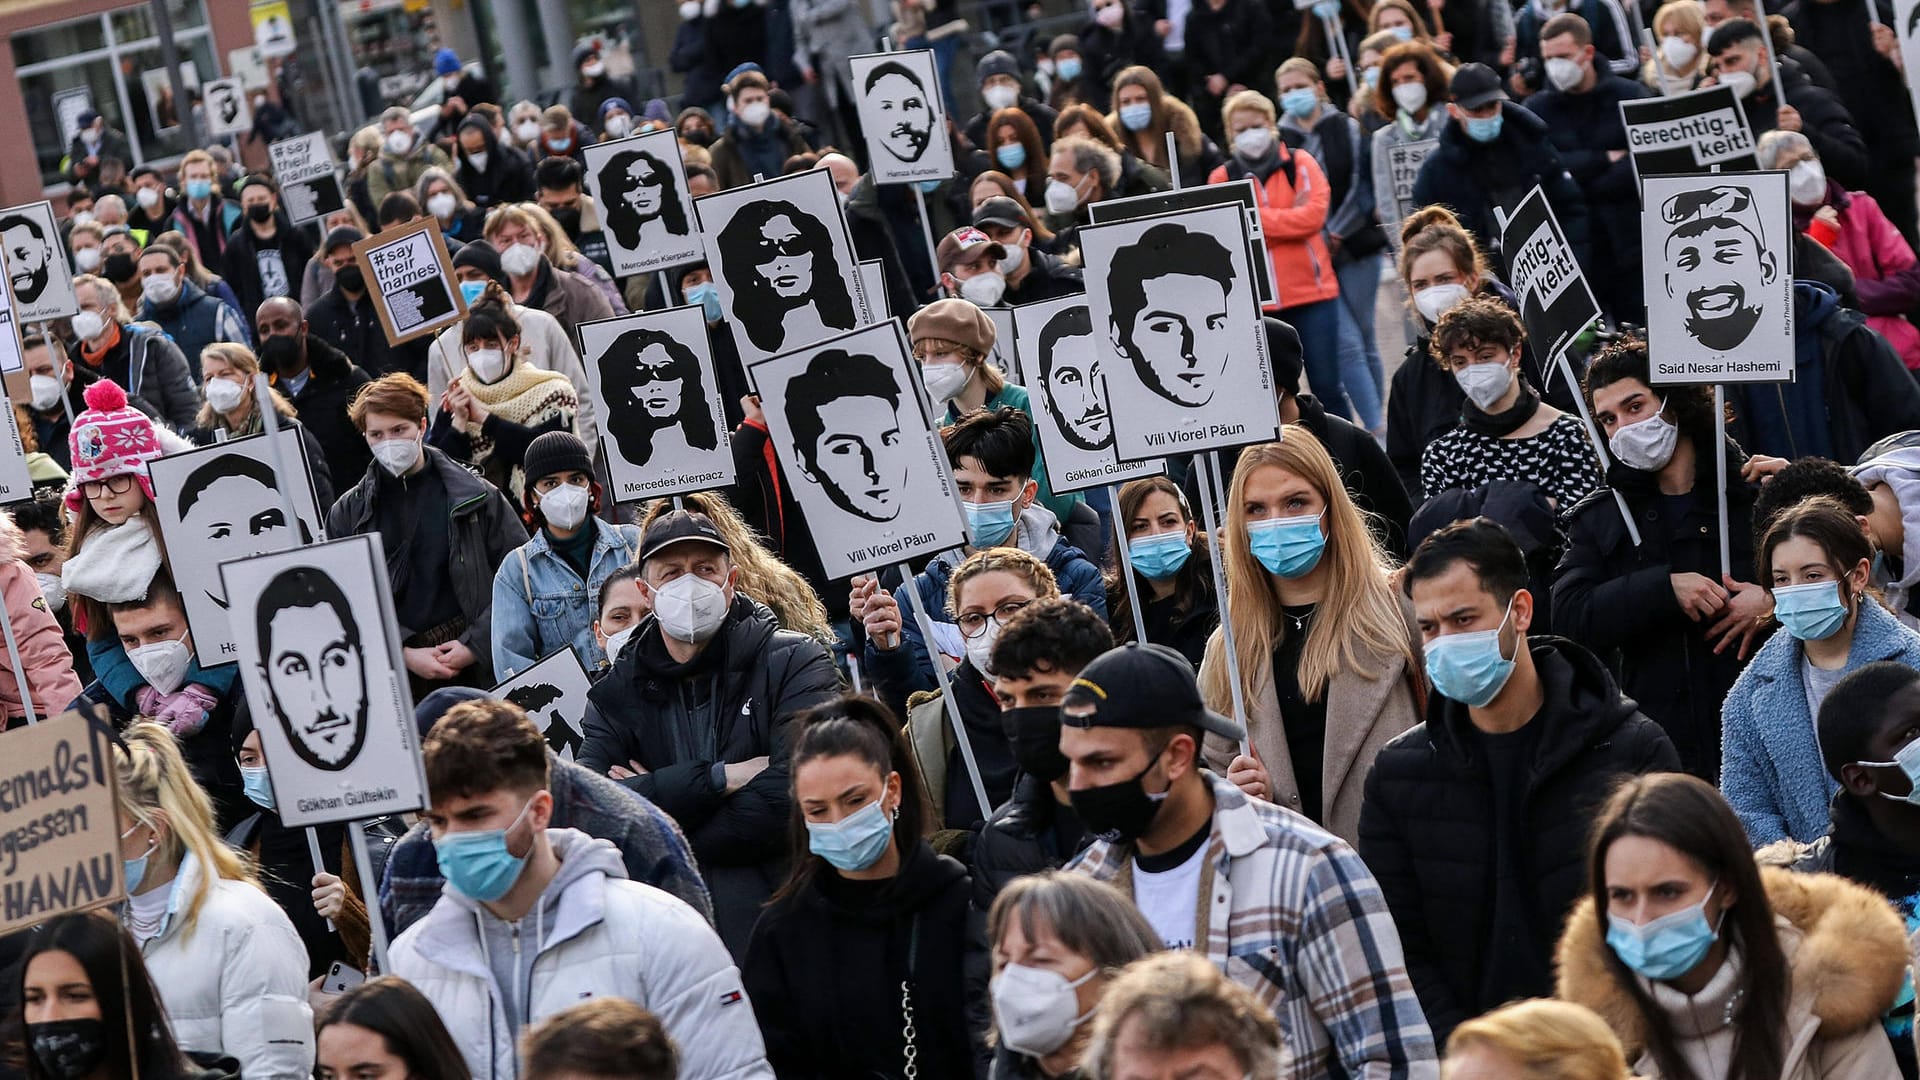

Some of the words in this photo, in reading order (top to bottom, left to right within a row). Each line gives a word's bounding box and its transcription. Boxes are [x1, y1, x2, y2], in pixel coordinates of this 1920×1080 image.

[1630, 117, 1733, 145] Gerechtig-
[274, 140, 311, 157] #say
[1698, 130, 1751, 158] keit!
[278, 153, 311, 171] their
[282, 161, 331, 181] names
[373, 243, 414, 266] #say
[621, 257, 659, 270] Mercedes
[661, 250, 695, 262] Kierpacz
[378, 257, 414, 280] their
[383, 263, 436, 292] names
[1535, 247, 1574, 299] keit!
[852, 270, 869, 324] #SayTheirNames
[1254, 325, 1269, 389] #SayTheirNames
[1658, 363, 1685, 374] Said
[1688, 363, 1723, 373] Nesar
[1727, 361, 1780, 372] Hashemi
[1145, 433, 1165, 446] Vili
[1168, 427, 1207, 443] Viorel
[1210, 423, 1245, 437] Păun
[926, 435, 950, 497] #SayTheirNames
[1065, 468, 1103, 481] Gökhan
[624, 478, 676, 493] Mercedes
[678, 471, 724, 484] Kierpacz
[847, 549, 867, 563] Vili
[867, 539, 903, 558] Viorel
[904, 532, 936, 548] Păun
[0, 804, 88, 876] gessen
[0, 853, 113, 921] HANAU
